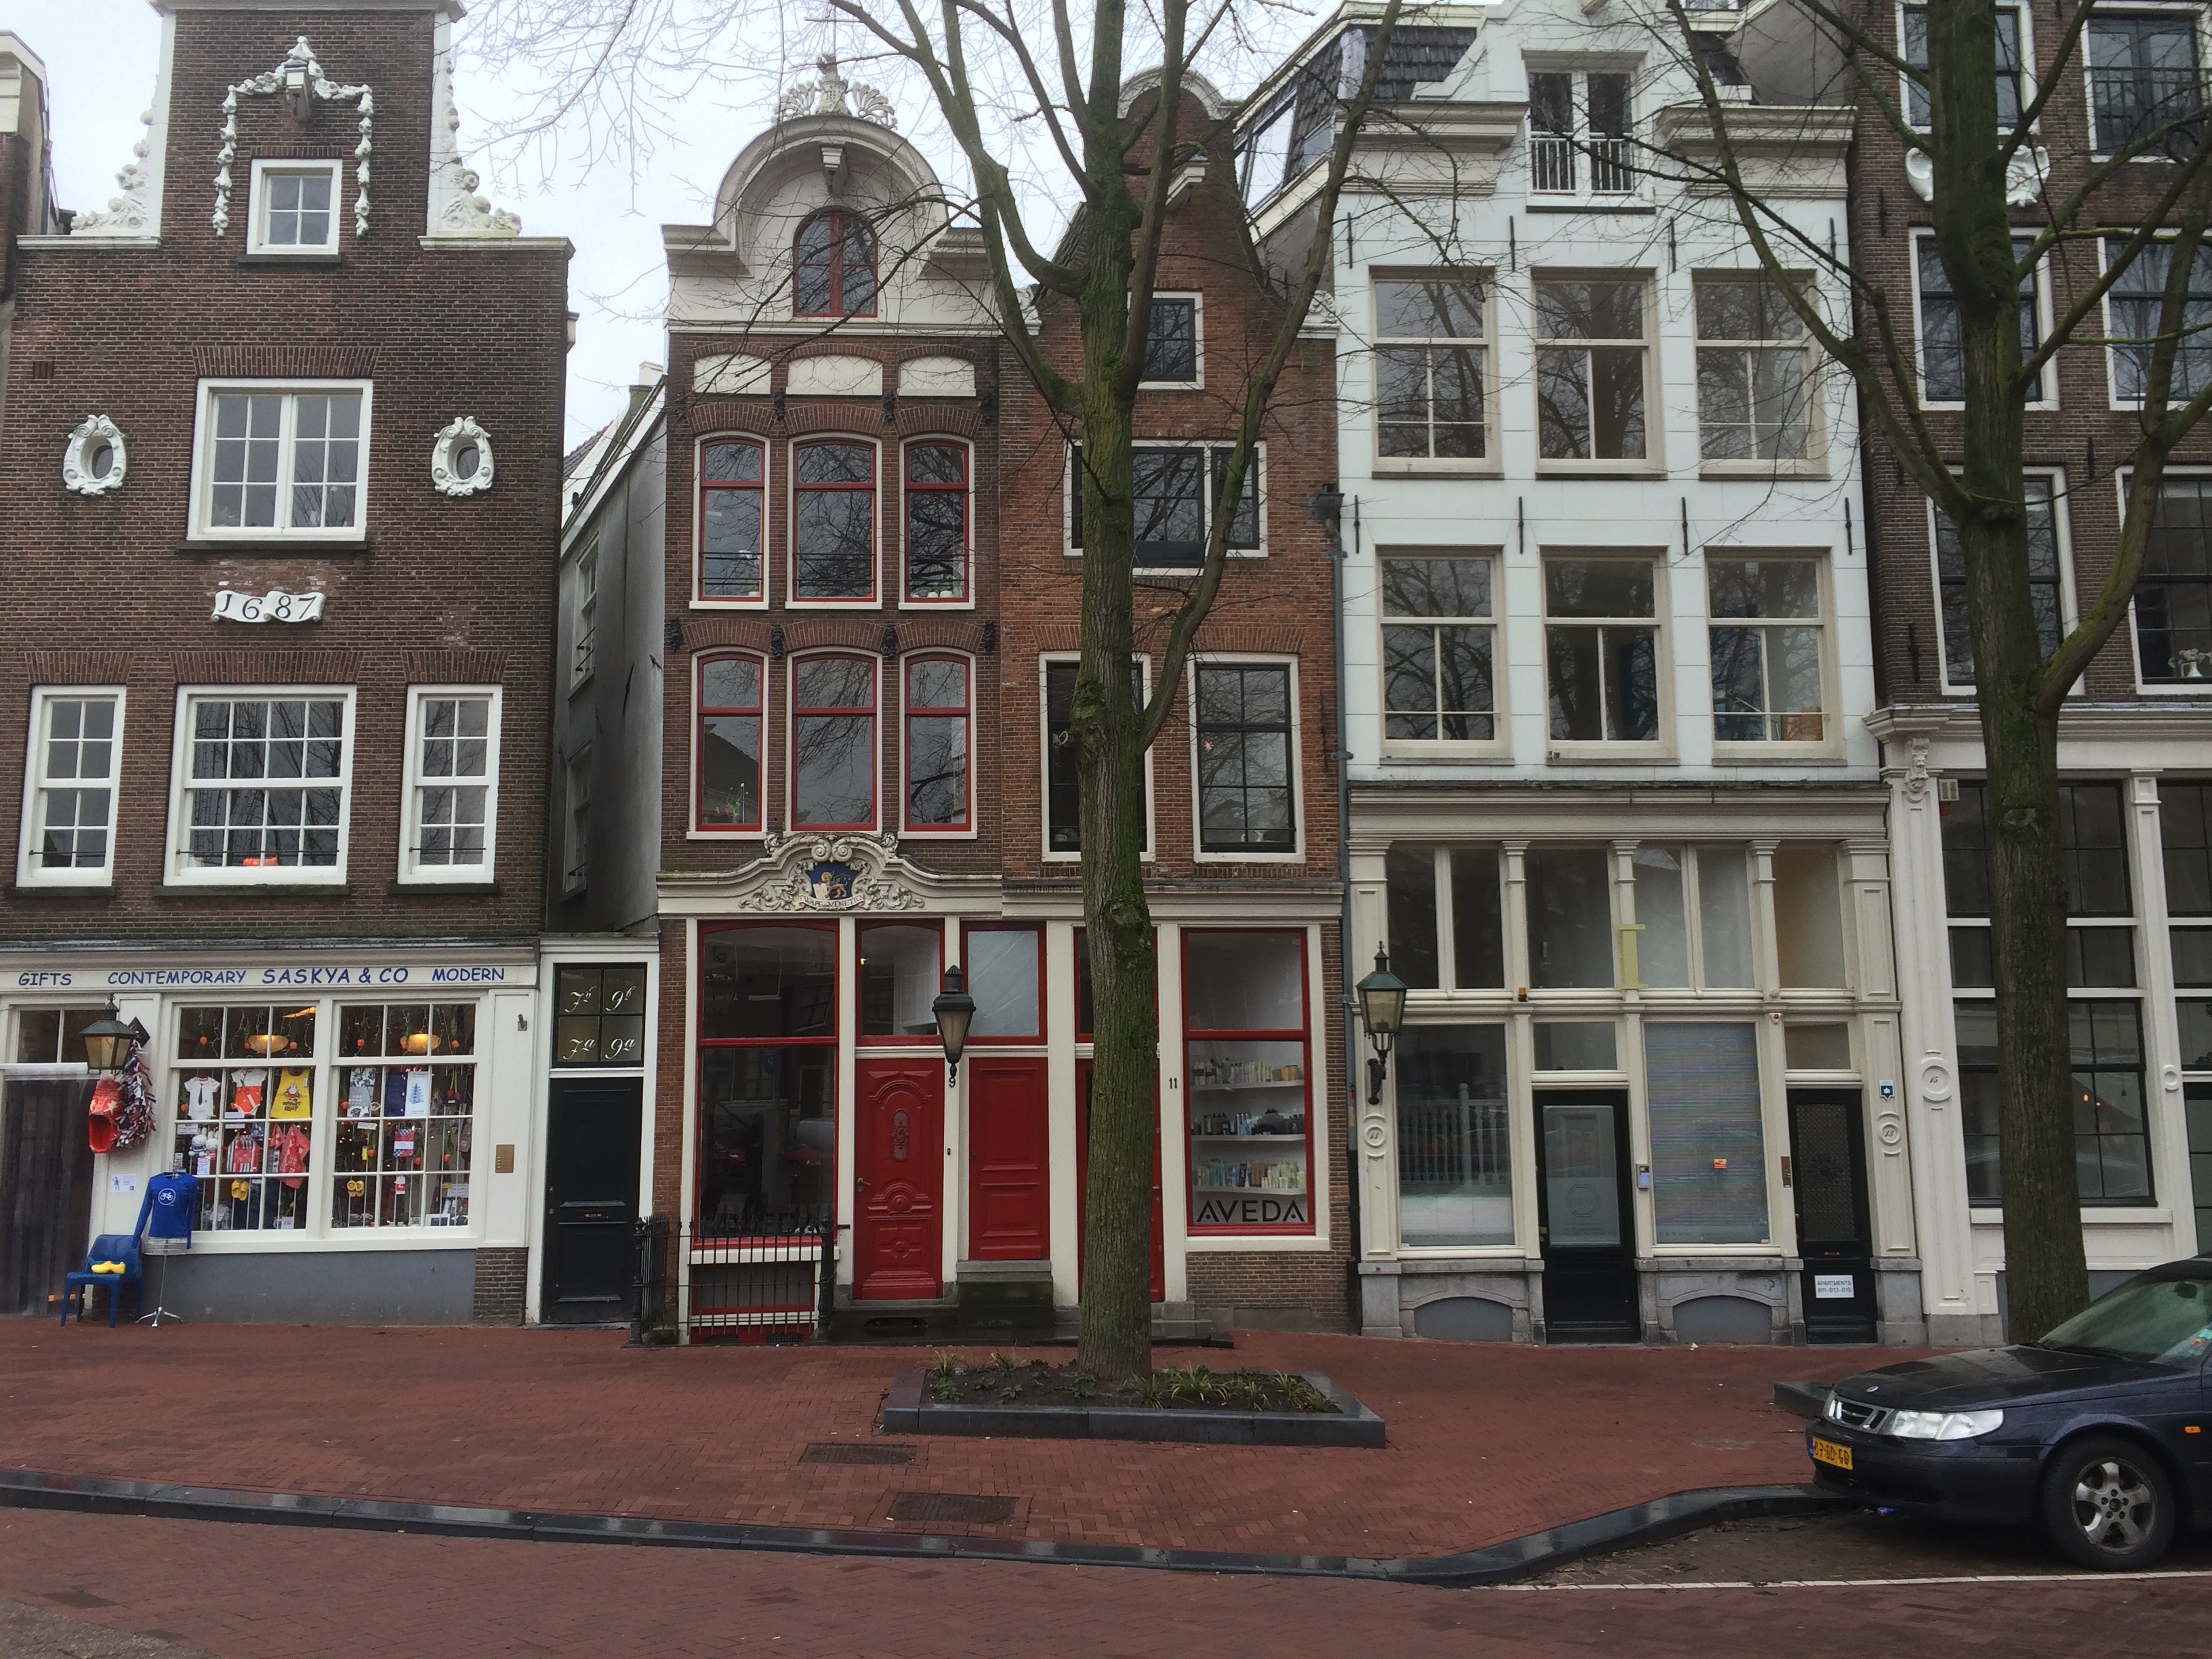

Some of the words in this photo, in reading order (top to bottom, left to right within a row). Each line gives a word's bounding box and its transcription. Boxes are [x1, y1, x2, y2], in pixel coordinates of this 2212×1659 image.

[18, 972, 72, 987] GIFTS
[108, 970, 247, 985] CONTEMPORARY
[262, 968, 350, 984] SASKYA
[358, 967, 371, 983] &
[379, 967, 409, 983] CO
[432, 968, 505, 982] MODERN
[949, 1077, 956, 1088] 9
[1169, 1077, 1178, 1089] 11
[1196, 1200, 1305, 1223] AVEDA
